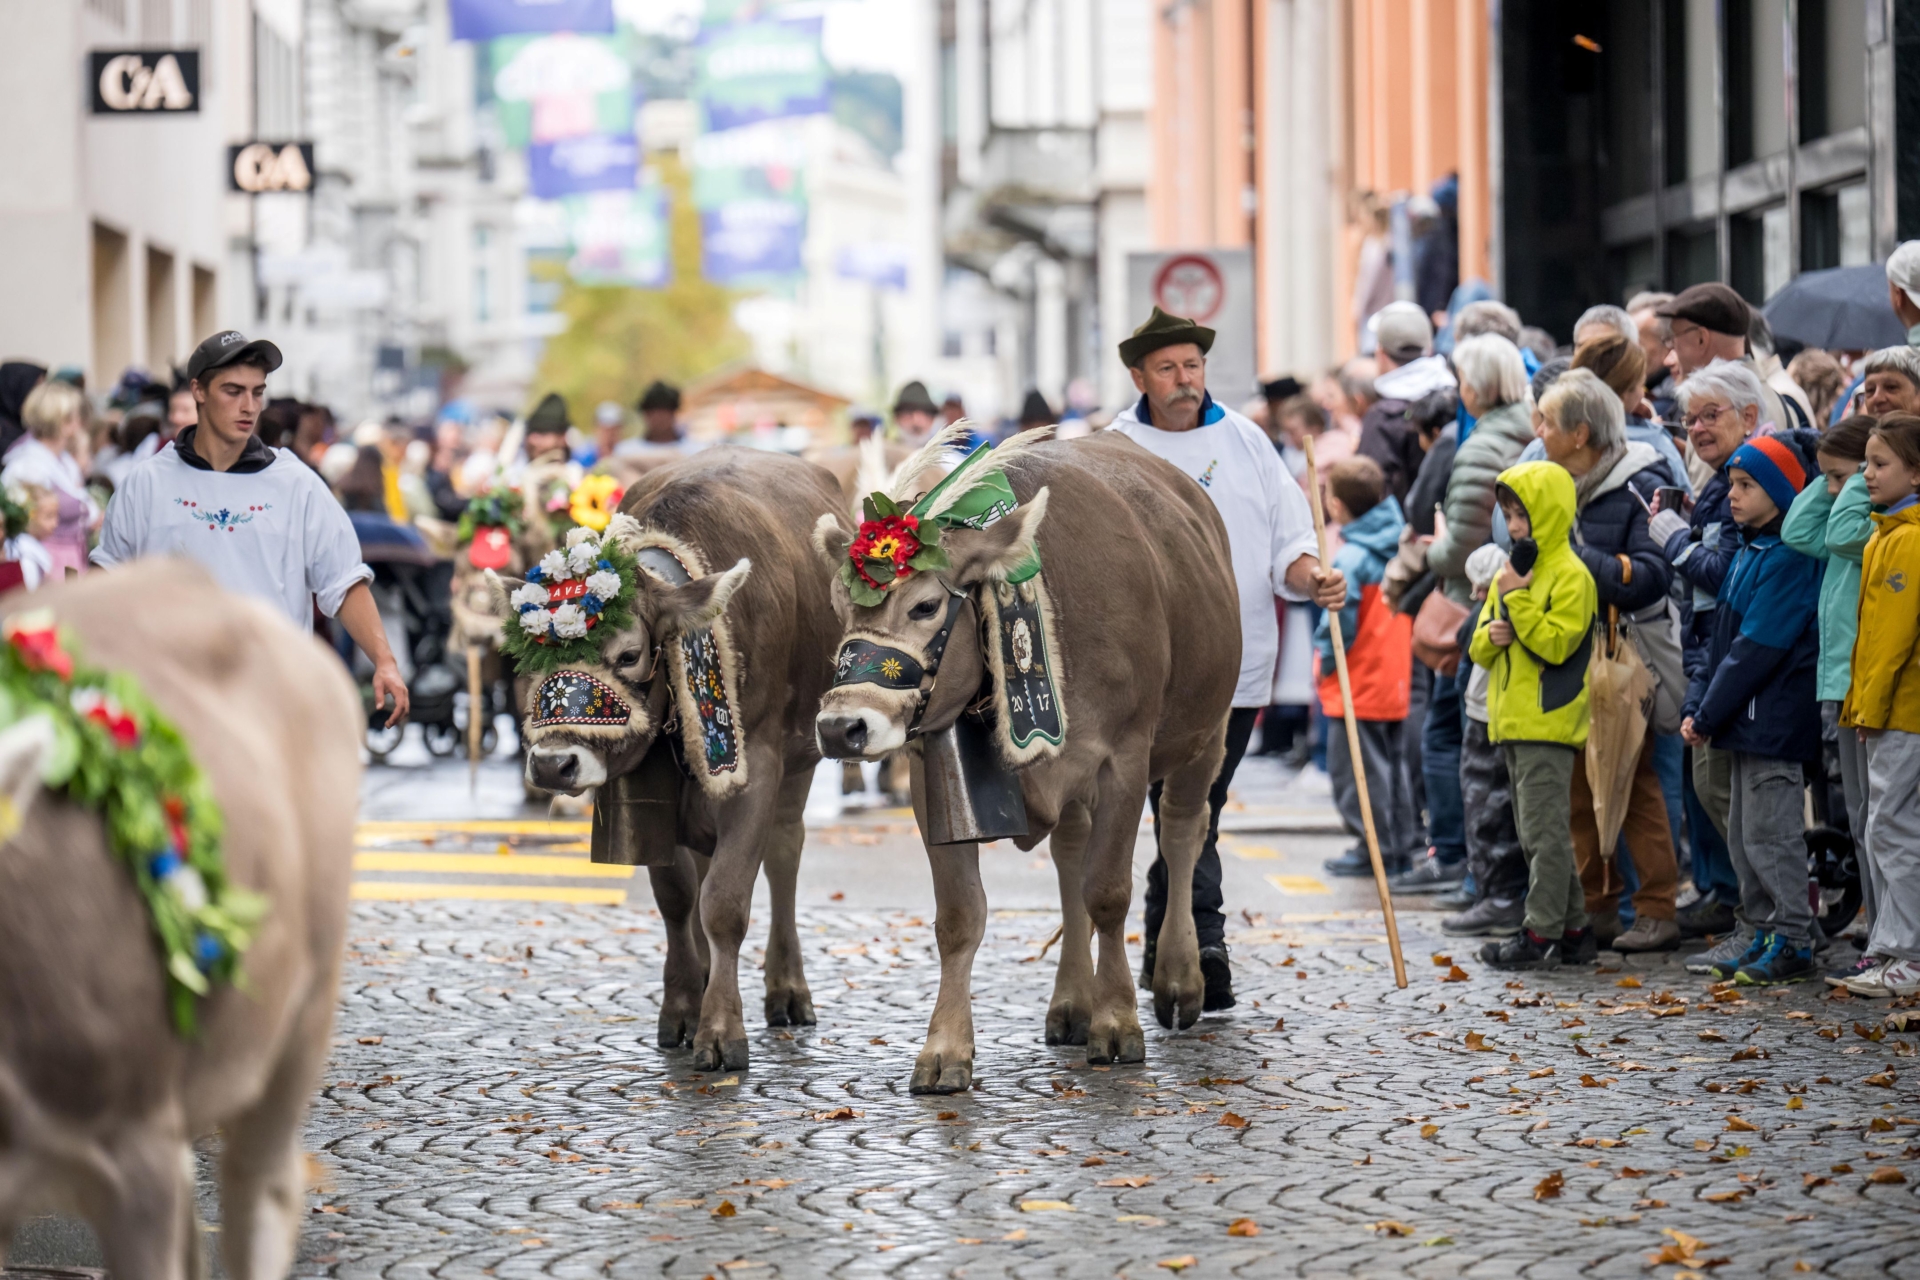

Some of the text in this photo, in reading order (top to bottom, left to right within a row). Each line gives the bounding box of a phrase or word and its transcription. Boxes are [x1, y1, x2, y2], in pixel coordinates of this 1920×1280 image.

[99, 54, 193, 110] C&A
[1011, 693, 1050, 713] 20 17
